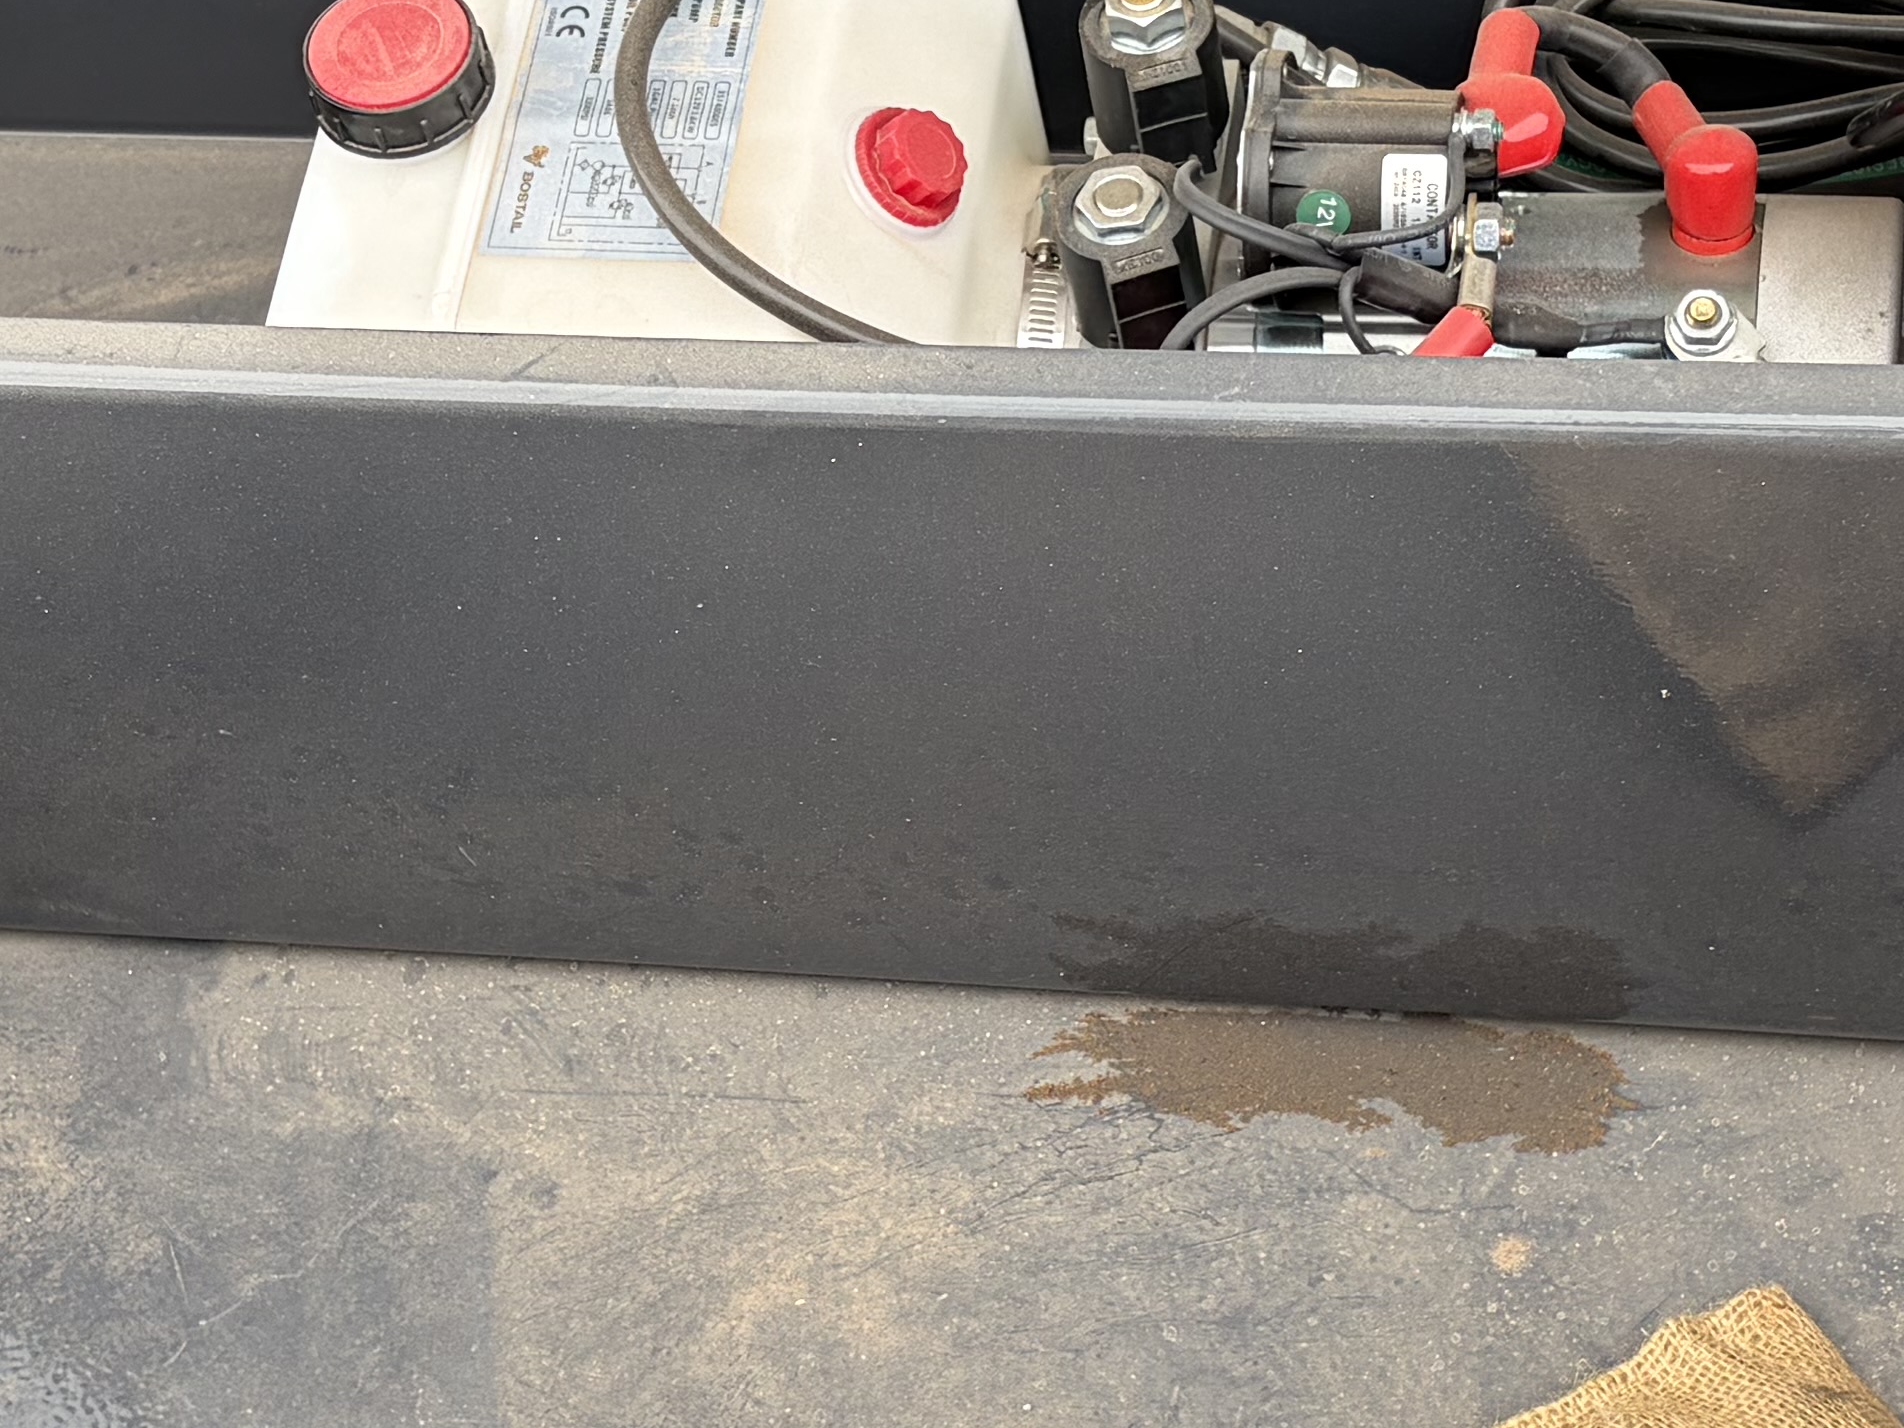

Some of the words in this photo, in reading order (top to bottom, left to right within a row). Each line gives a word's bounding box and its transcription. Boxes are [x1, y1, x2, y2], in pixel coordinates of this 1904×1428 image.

[509, 170, 535, 234] BOSTAIL
[1315, 197, 1338, 227] 12
[1425, 183, 1439, 251] CONTOR
